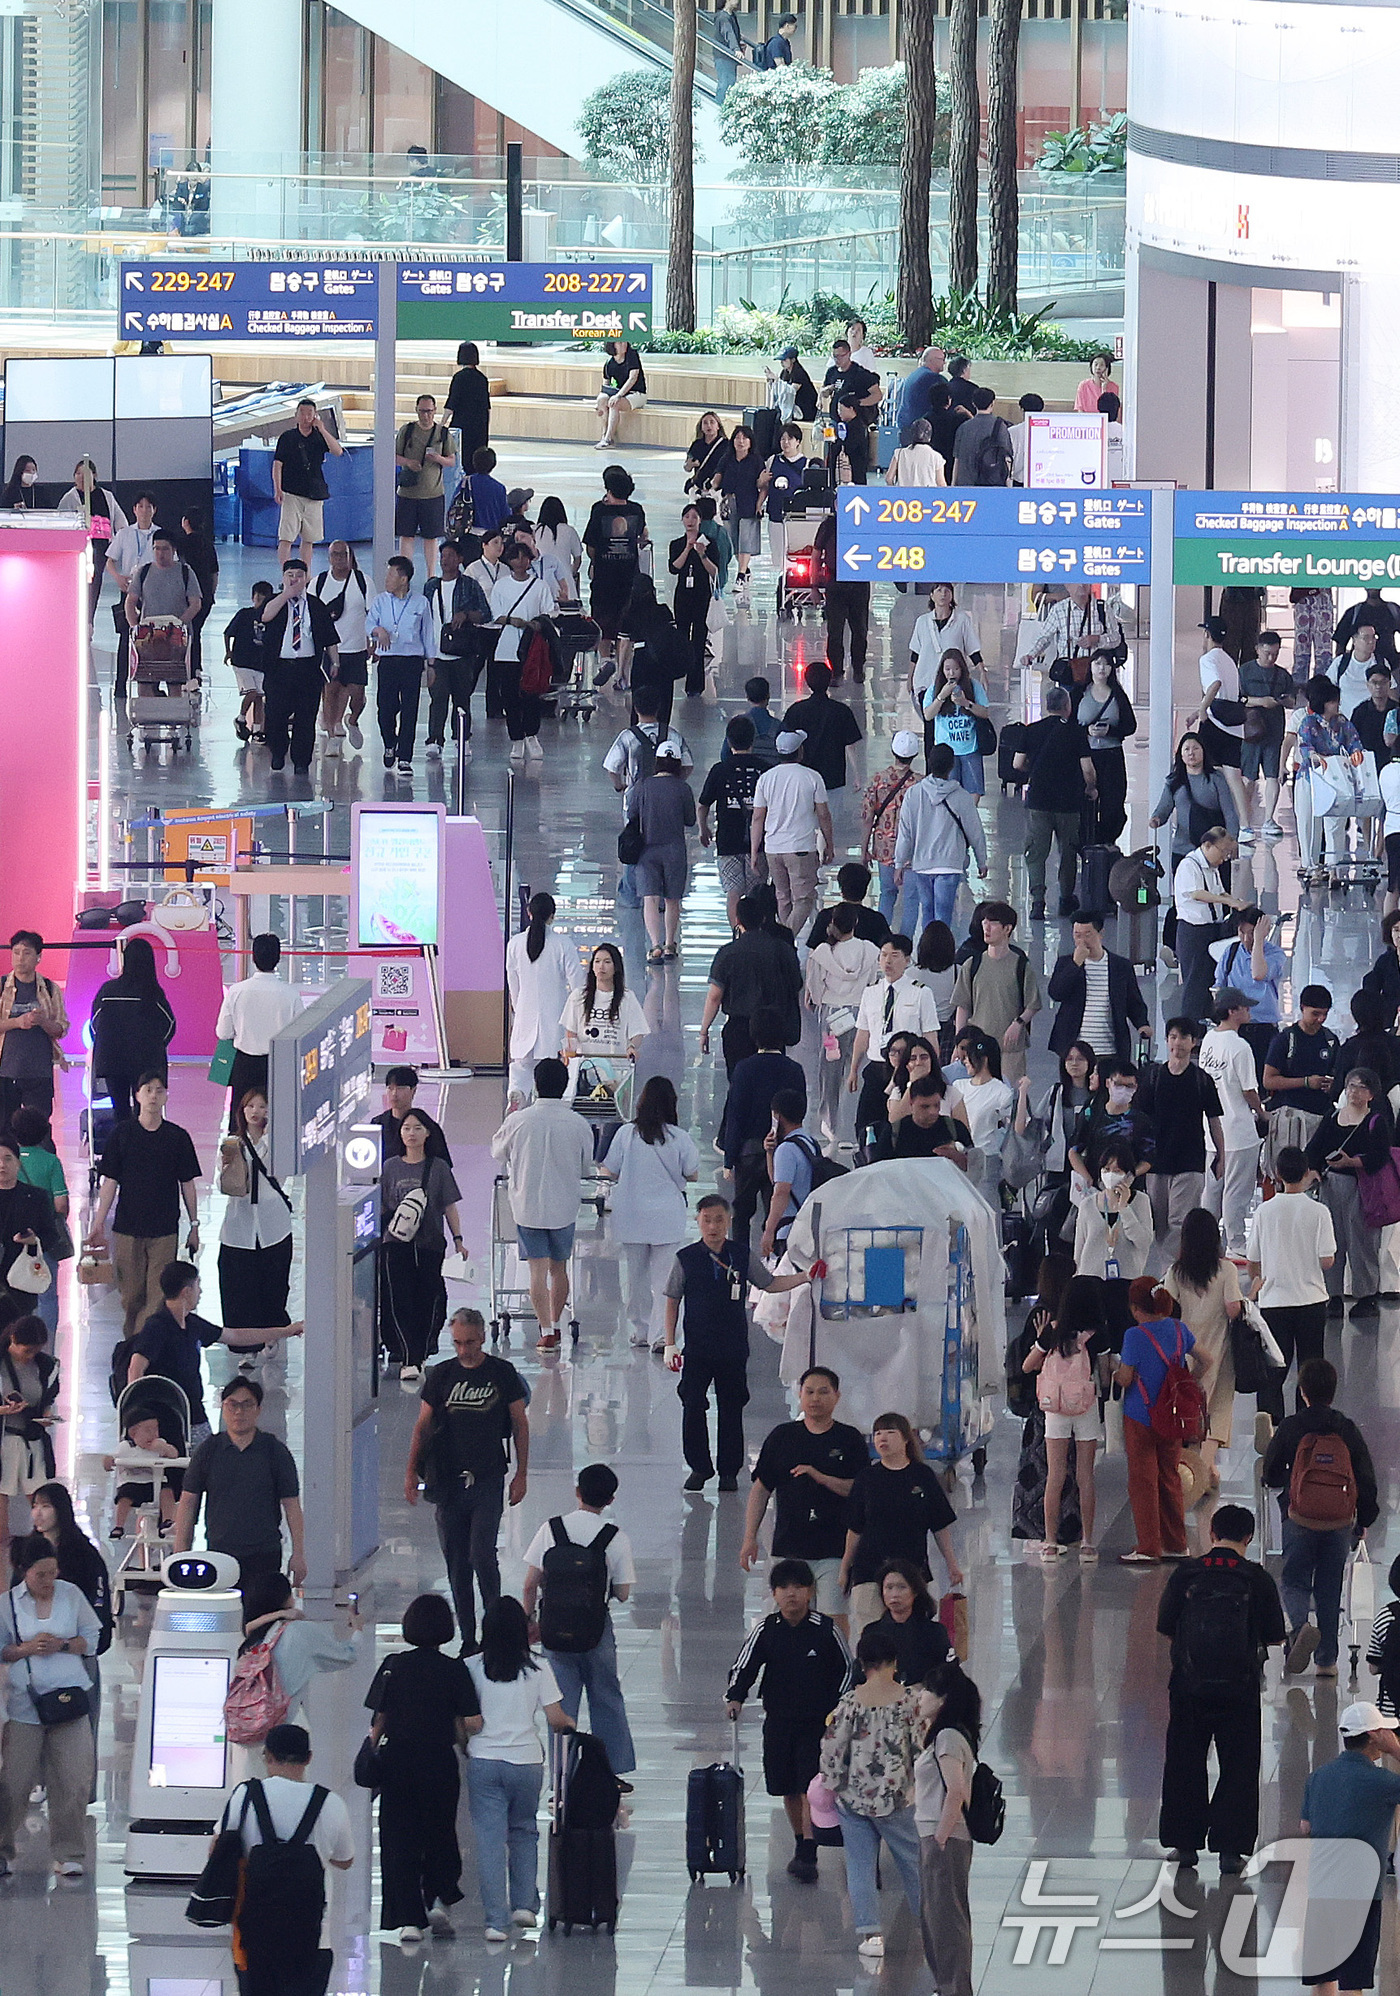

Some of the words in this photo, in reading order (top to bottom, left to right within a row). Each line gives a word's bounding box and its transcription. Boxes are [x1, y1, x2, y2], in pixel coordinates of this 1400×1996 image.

[151, 271, 235, 291] 229-247
[270, 272, 319, 292] 탑승구
[323, 283, 356, 295] Gates
[420, 283, 453, 295] Gates
[456, 272, 505, 292] 탑승구
[543, 273, 625, 292] 208-227
[510, 310, 578, 327] Transfer
[582, 310, 623, 327] Desk
[247, 323, 282, 334] Checked
[284, 323, 321, 335] Baggage
[322, 323, 364, 335] Inspection
[366, 323, 373, 332] A
[572, 329, 605, 338] Korean
[607, 329, 623, 338] Air
[1050, 427, 1101, 439] PROMOTION
[877, 500, 976, 523] 208-247
[1018, 501, 1077, 525] 탑승구
[1083, 515, 1121, 529] Gates
[1195, 516, 1238, 529] Checked
[1239, 517, 1284, 533] Baggage
[1286, 518, 1337, 533] Inspection
[1338, 519, 1349, 531] A
[877, 546, 925, 570] 248
[1017, 548, 1078, 572] 탑승구
[1217, 552, 1302, 575] Transfer
[1083, 562, 1121, 576] Gates
[948, 730, 971, 741] WAVE
[445, 1381, 494, 1406] Maui
